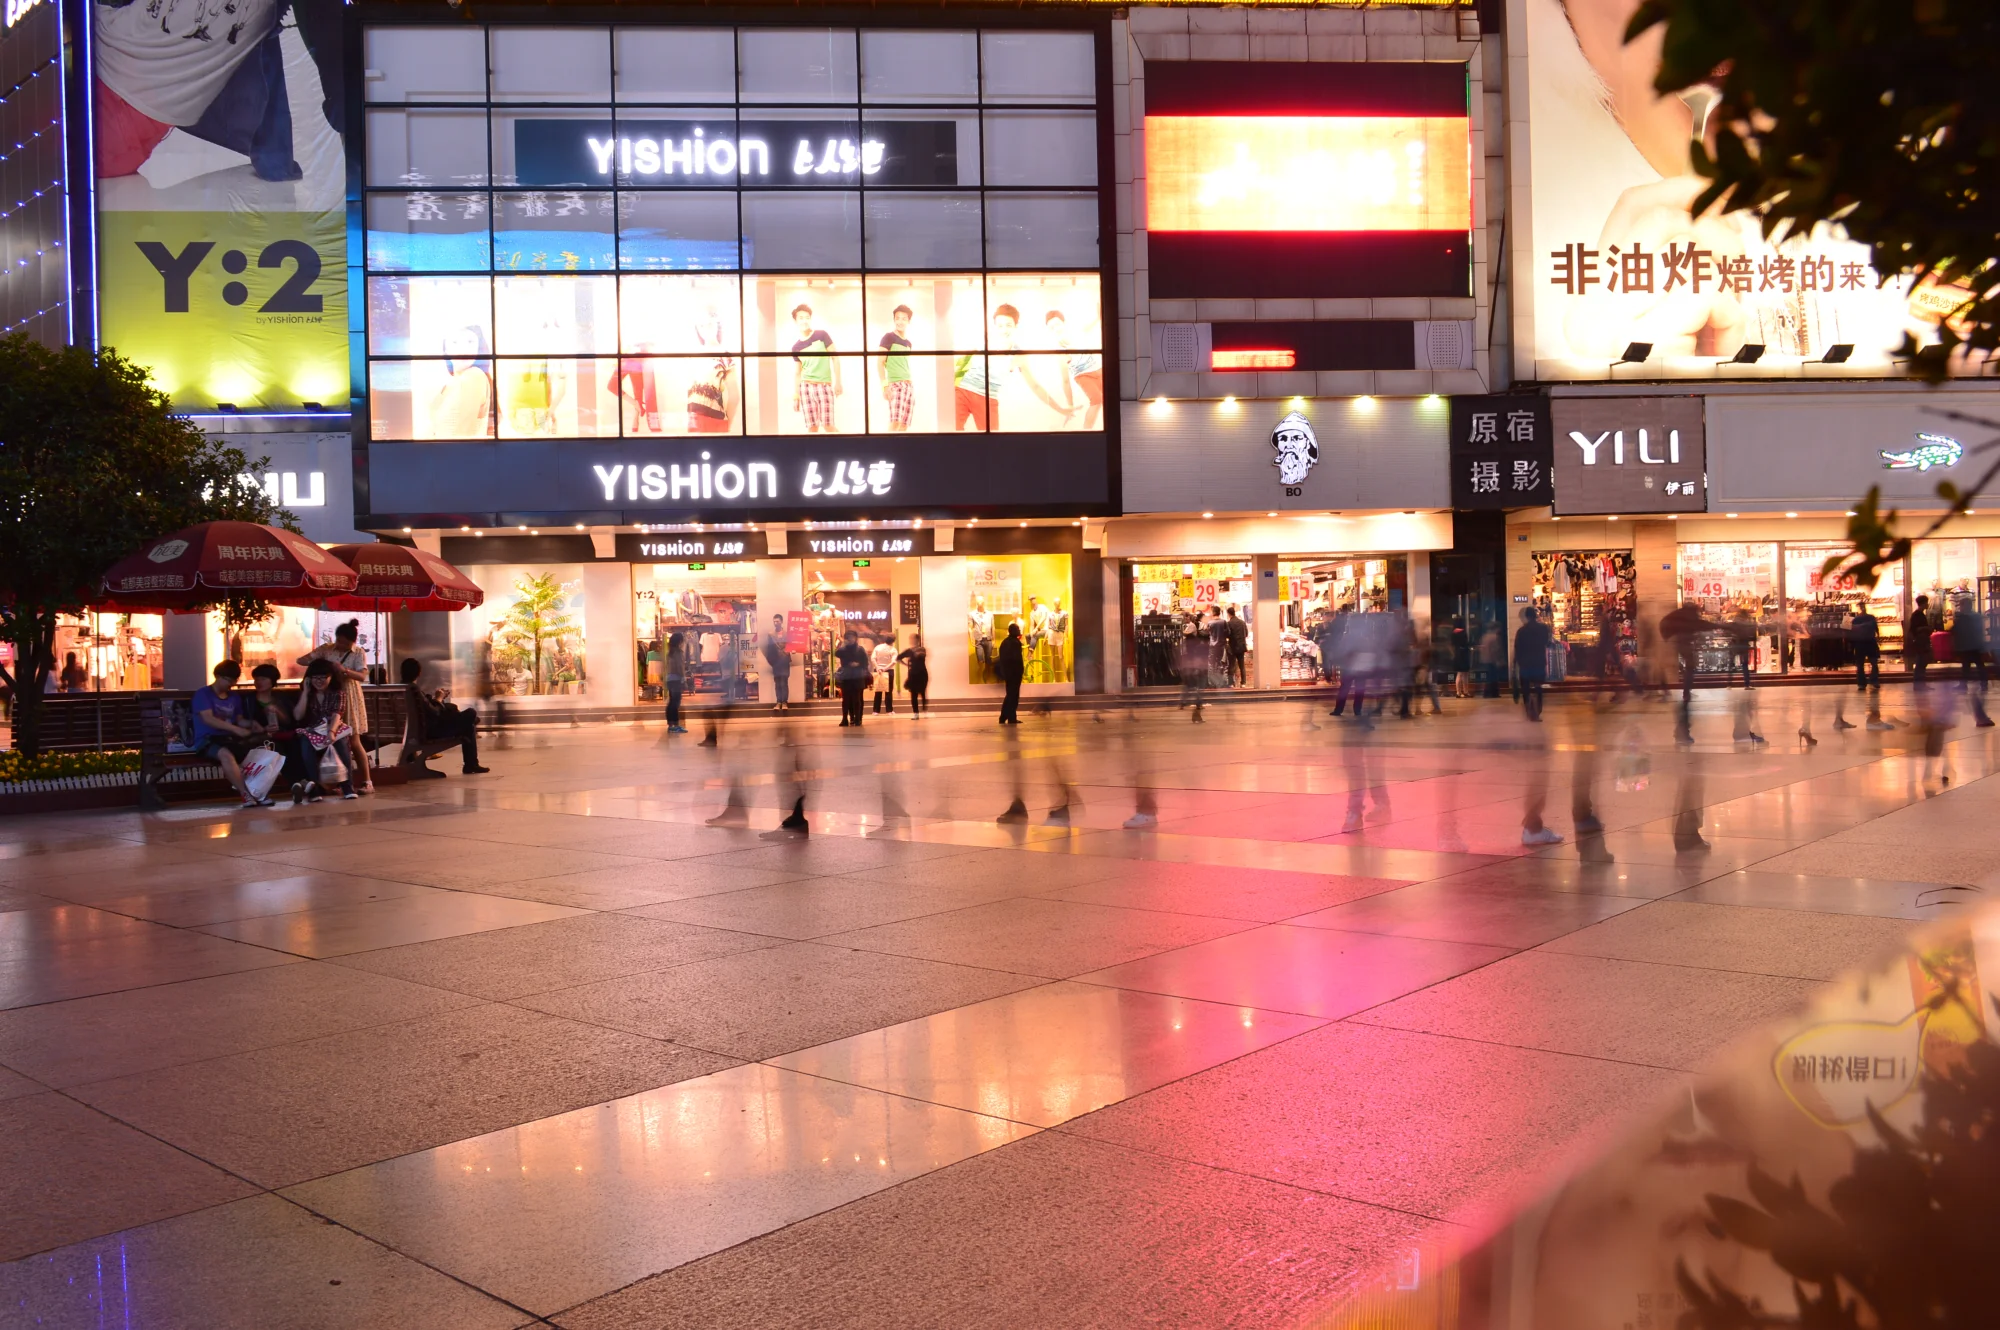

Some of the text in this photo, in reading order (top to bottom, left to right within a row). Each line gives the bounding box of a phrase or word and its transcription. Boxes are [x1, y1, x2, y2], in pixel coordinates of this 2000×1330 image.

[134, 239, 323, 313] Y:2
[256, 316, 266, 325] by
[1468, 409, 1535, 444] 原宿
[1568, 428, 1679, 465] YILI
[1470, 460, 1541, 493] 摄影
[1285, 487, 1302, 497] BO
[1664, 481, 1696, 496] 伊丽
[217, 545, 285, 561] 周年庆典
[219, 570, 292, 583] 成都美容整形医院
[360, 564, 414, 576] 周年庆典
[121, 574, 185, 590] 成都美容整形医院
[1291, 579, 1310, 600] 15
[1702, 583, 1722, 596] 49
[1832, 575, 1854, 591] 39
[635, 590, 655, 600] Y:2
[1196, 584, 1215, 603] 29
[1144, 597, 1159, 610] 29
